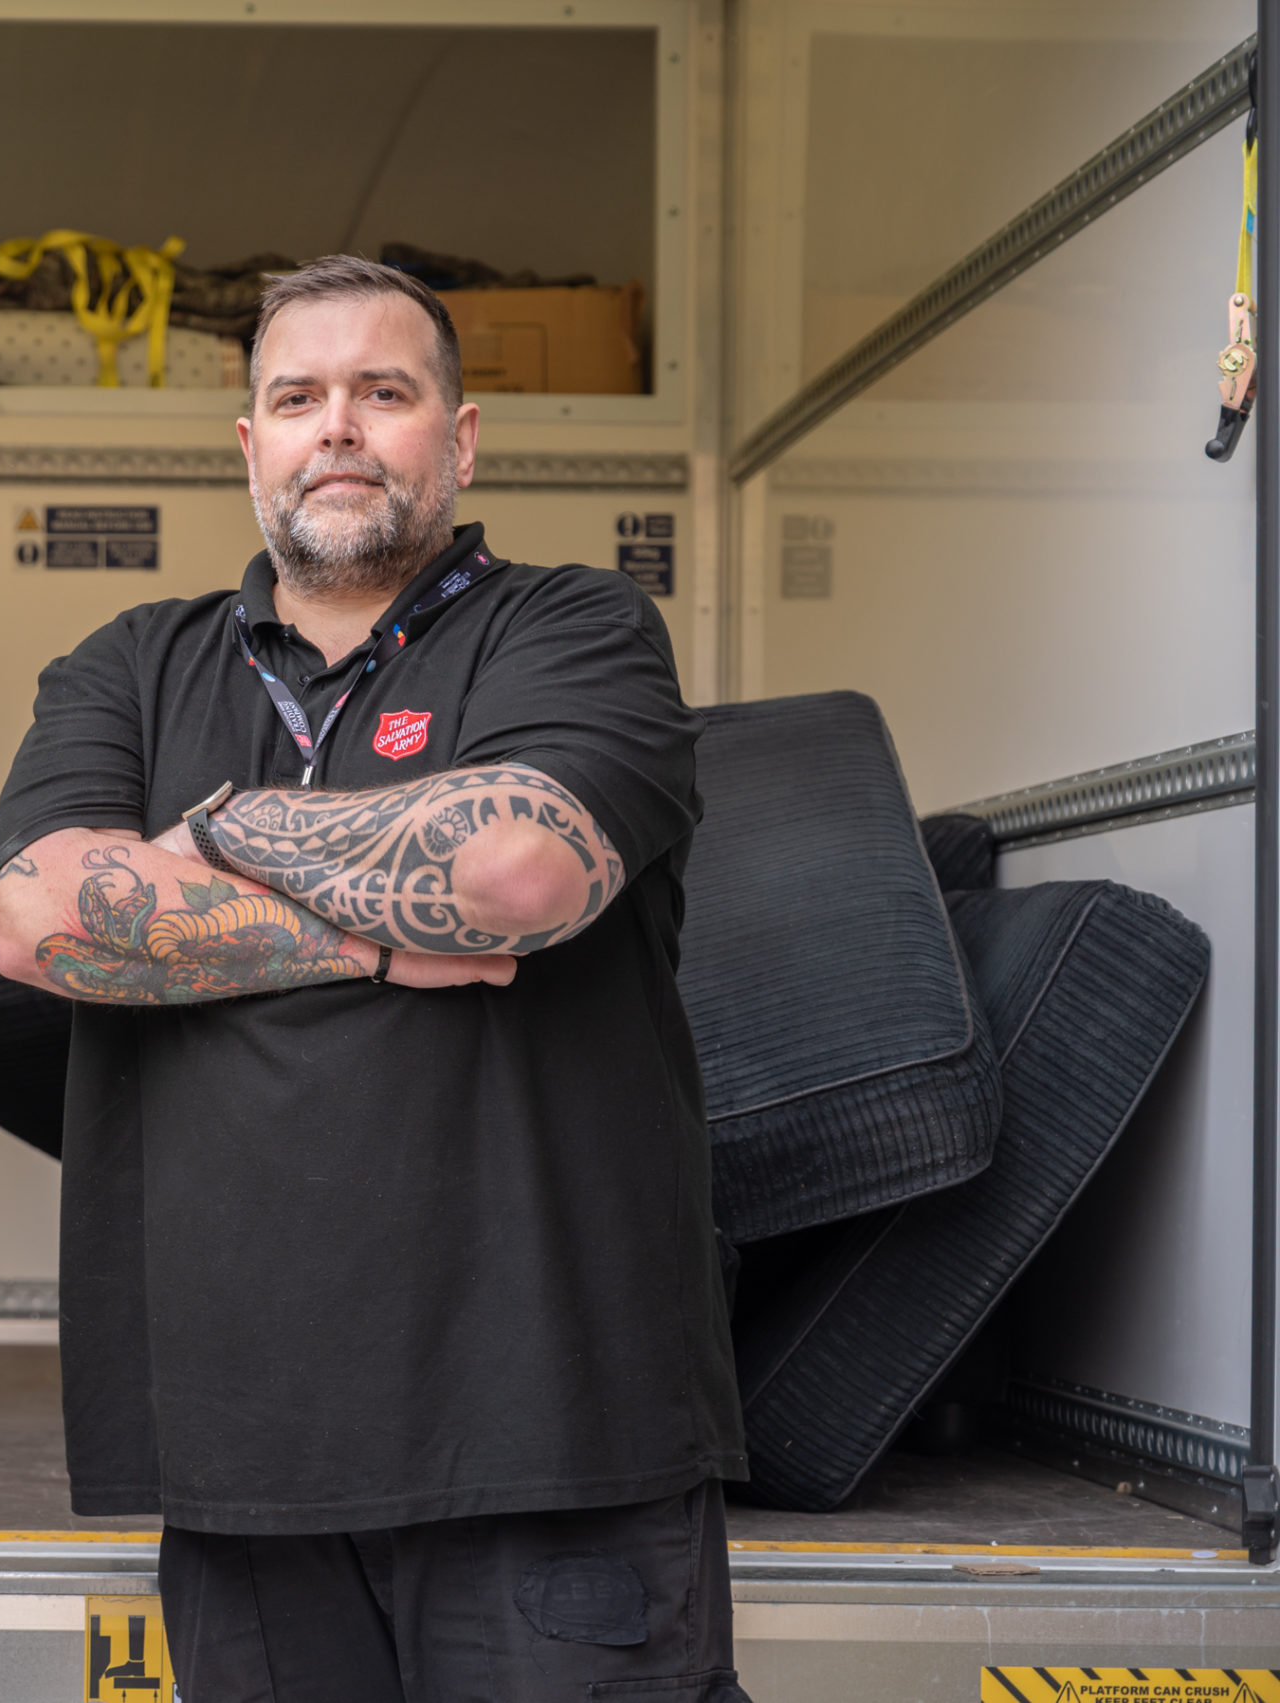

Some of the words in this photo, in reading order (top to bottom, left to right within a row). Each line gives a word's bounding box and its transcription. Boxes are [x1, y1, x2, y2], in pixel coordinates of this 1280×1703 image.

[377, 717, 427, 747] SALVATION
[388, 716, 408, 731] THE
[391, 732, 422, 753] ARMY
[1080, 1685, 1150, 1696] PLATFORM
[1153, 1686, 1181, 1696] CAN
[1185, 1686, 1230, 1697] CRUSH
